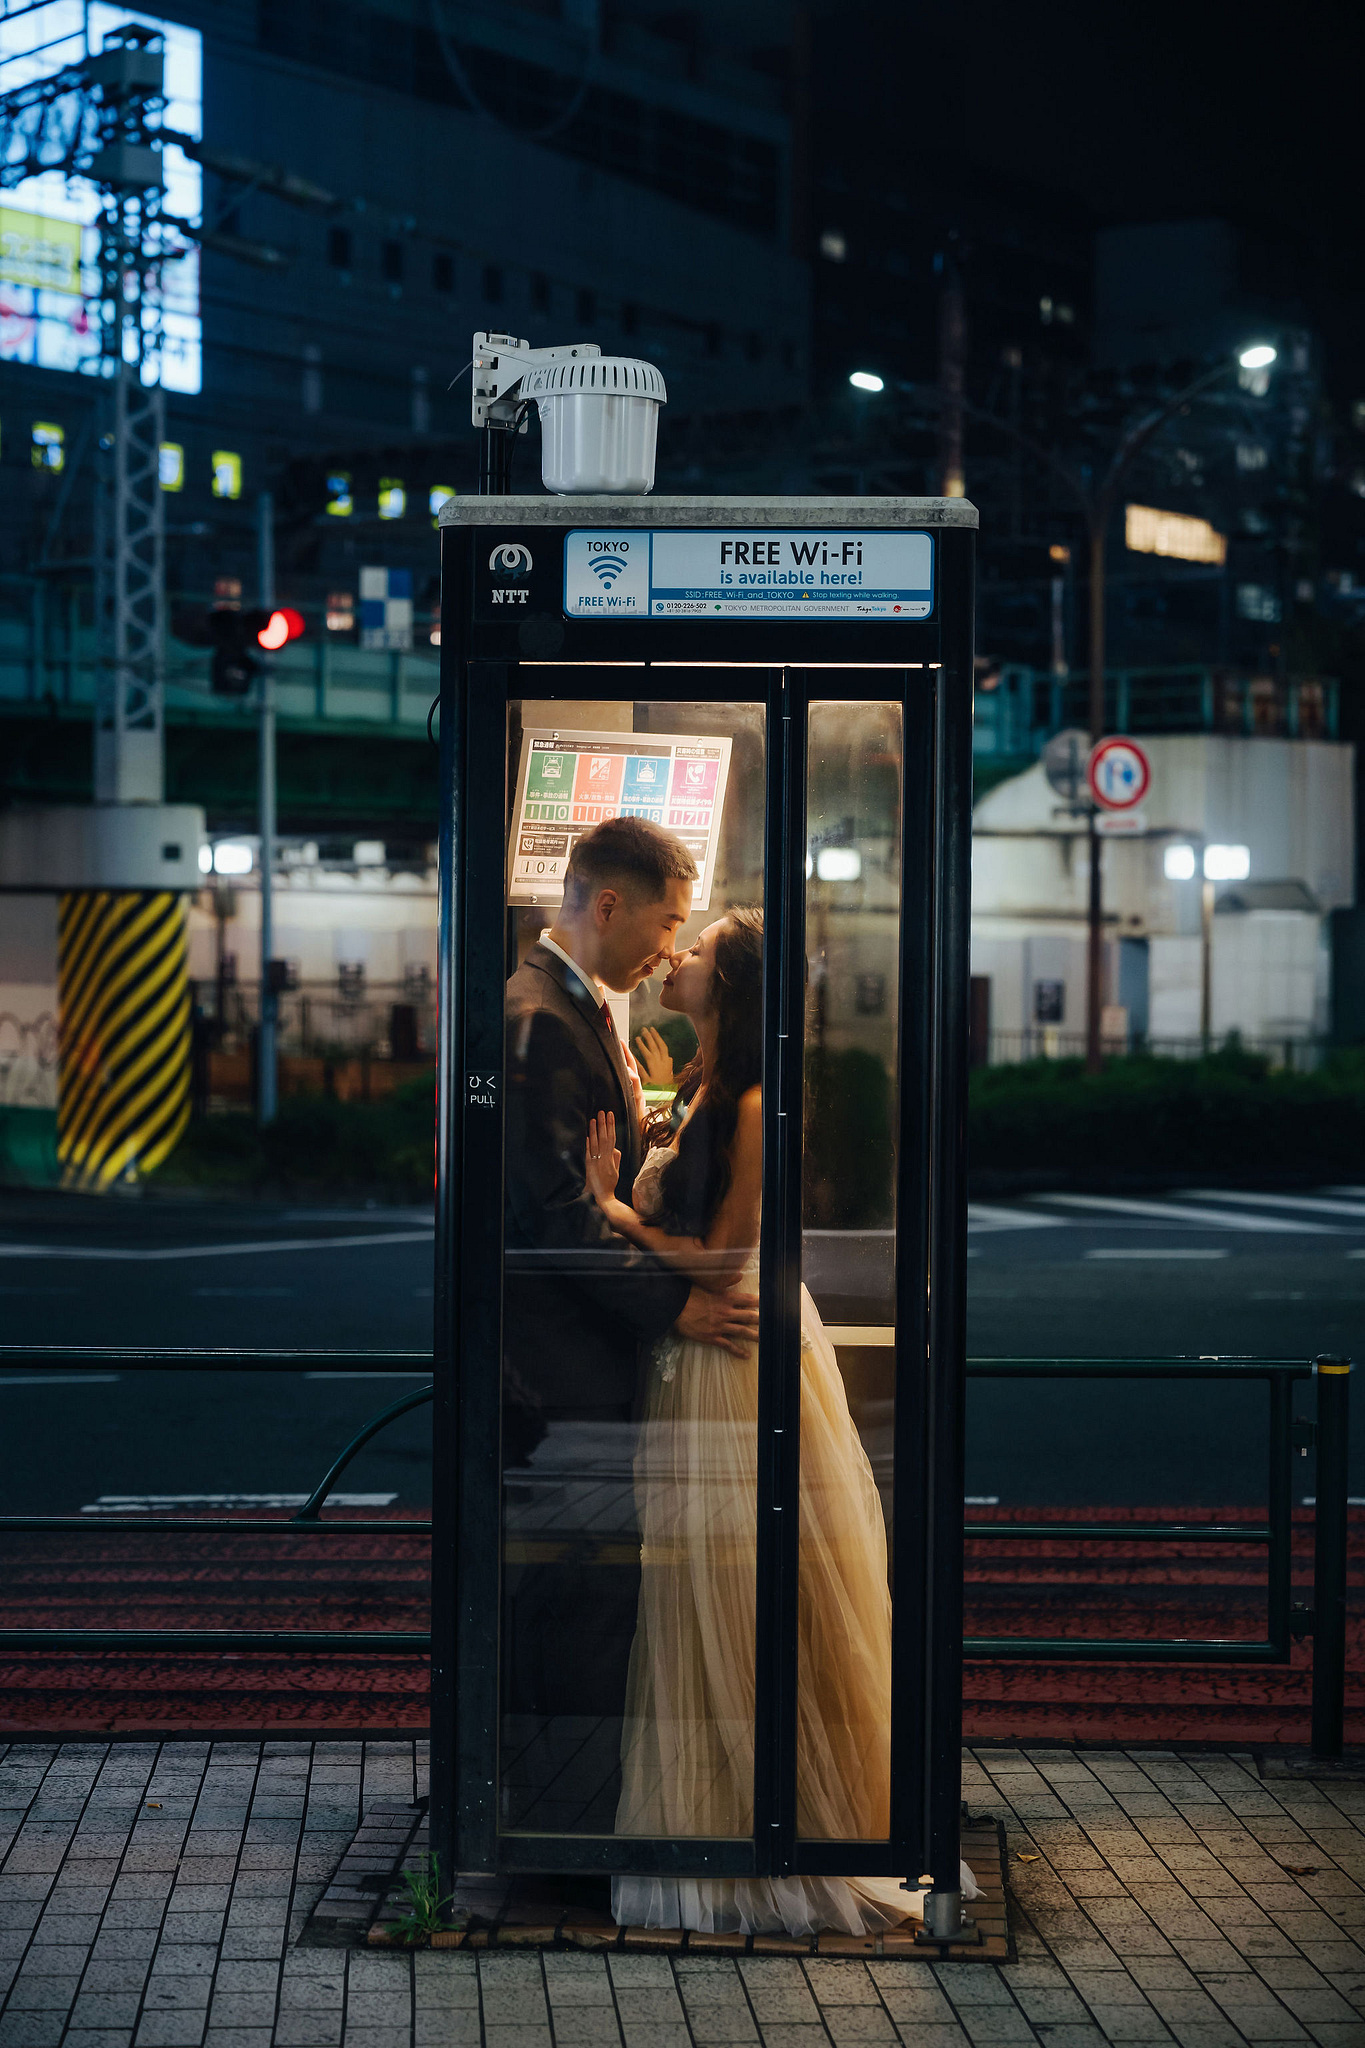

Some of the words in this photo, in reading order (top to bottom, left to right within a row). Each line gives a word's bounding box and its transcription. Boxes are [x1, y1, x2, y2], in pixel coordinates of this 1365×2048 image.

[586, 541, 630, 552] TOKYO
[720, 541, 781, 565] FREE
[790, 541, 863, 566] Wi-Fi
[720, 570, 733, 585] is
[738, 570, 815, 585] available
[820, 570, 863, 585] here!
[491, 589, 530, 604] NTT
[578, 597, 604, 607] FREE
[606, 596, 636, 607] Wi-Fi
[812, 591, 828, 600] Stop
[829, 591, 851, 600] texting
[852, 591, 869, 599] while
[869, 591, 900, 600] walking.
[724, 604, 748, 612] TOKYO
[530, 805, 567, 820] 110
[576, 807, 614, 820] 119
[625, 809, 660, 823] 118
[673, 811, 706, 825] 171
[525, 861, 557, 874] 104
[468, 1075, 497, 1089] ひく
[470, 1094, 496, 1104] PULL
